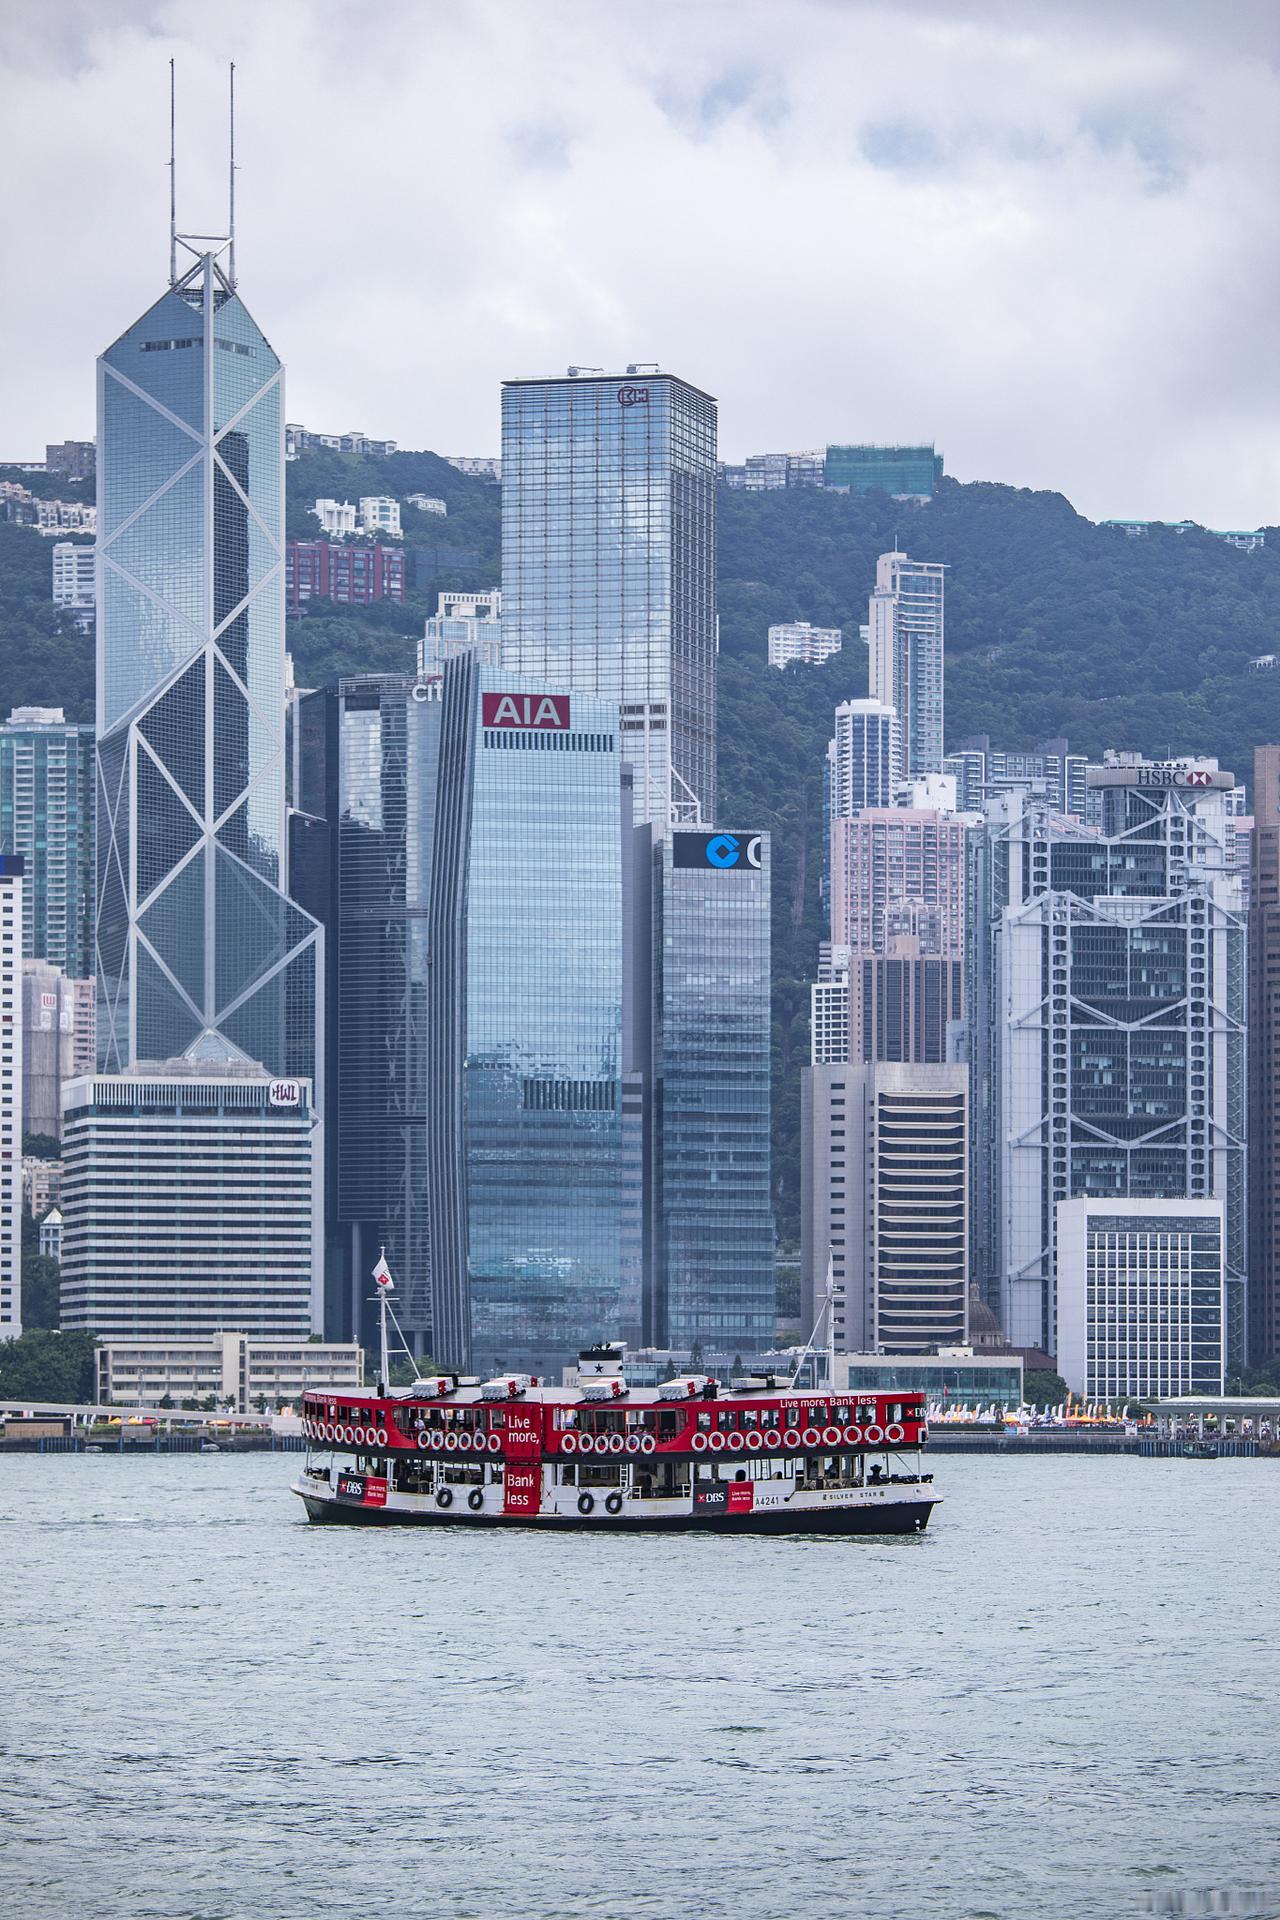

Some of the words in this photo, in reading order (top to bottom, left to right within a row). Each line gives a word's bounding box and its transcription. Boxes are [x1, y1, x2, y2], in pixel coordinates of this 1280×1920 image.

[493, 696, 561, 725] AIA
[1137, 770, 1185, 785] HSBC
[272, 1084, 297, 1101] HWL
[780, 1399, 799, 1408] Live
[800, 1399, 827, 1408] more,
[829, 1396, 854, 1406] Bank
[857, 1395, 877, 1405] less
[508, 1416, 530, 1428] Live
[508, 1432, 540, 1444] more,
[507, 1474, 535, 1487] Bank
[346, 1481, 363, 1495] DBS
[507, 1491, 529, 1505] less
[706, 1492, 724, 1503] DBS
[755, 1497, 779, 1506] A4241
